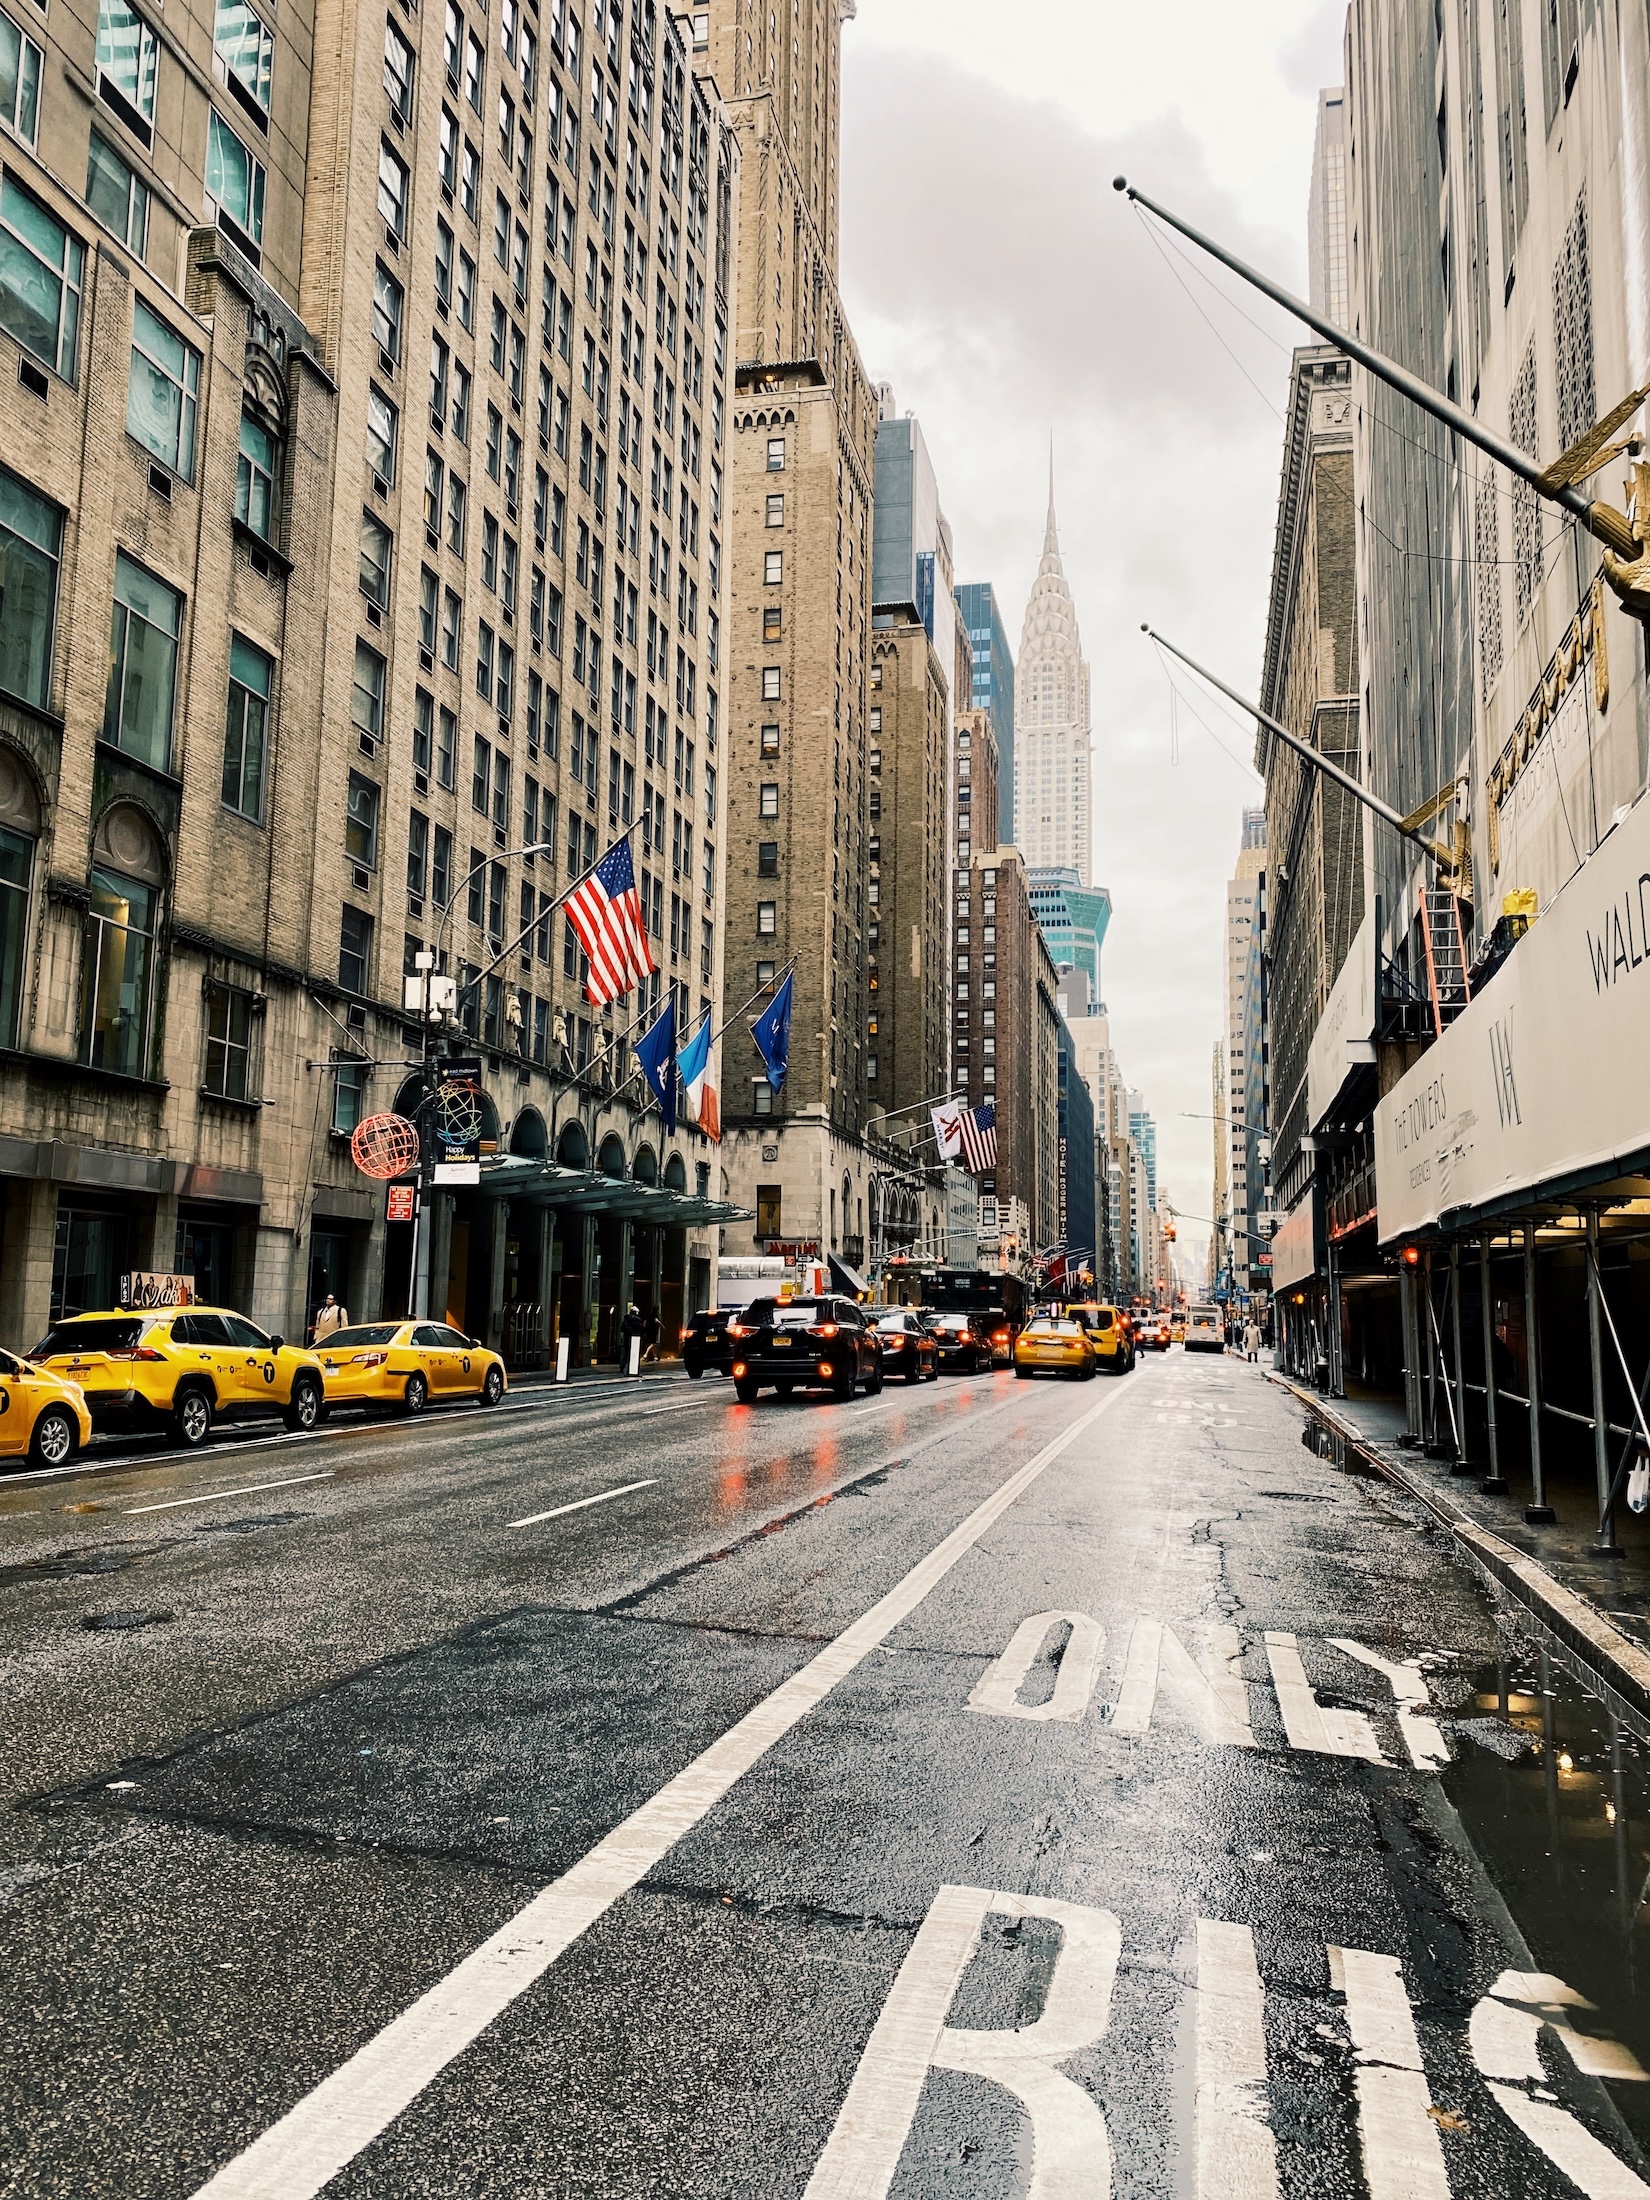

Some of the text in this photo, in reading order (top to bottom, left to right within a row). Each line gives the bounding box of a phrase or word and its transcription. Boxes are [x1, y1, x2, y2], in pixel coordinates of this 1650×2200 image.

[1394, 1109, 1408, 1155] THE
[1408, 1073, 1448, 1142] TOWERS
[445, 1146, 465, 1154] Happy
[445, 1154, 476, 1163] Holidays
[1059, 1137, 1067, 1239] HOTEL ROGER SMITH
[265, 1365, 273, 1381] T
[963, 1610, 1453, 1771] ONLY
